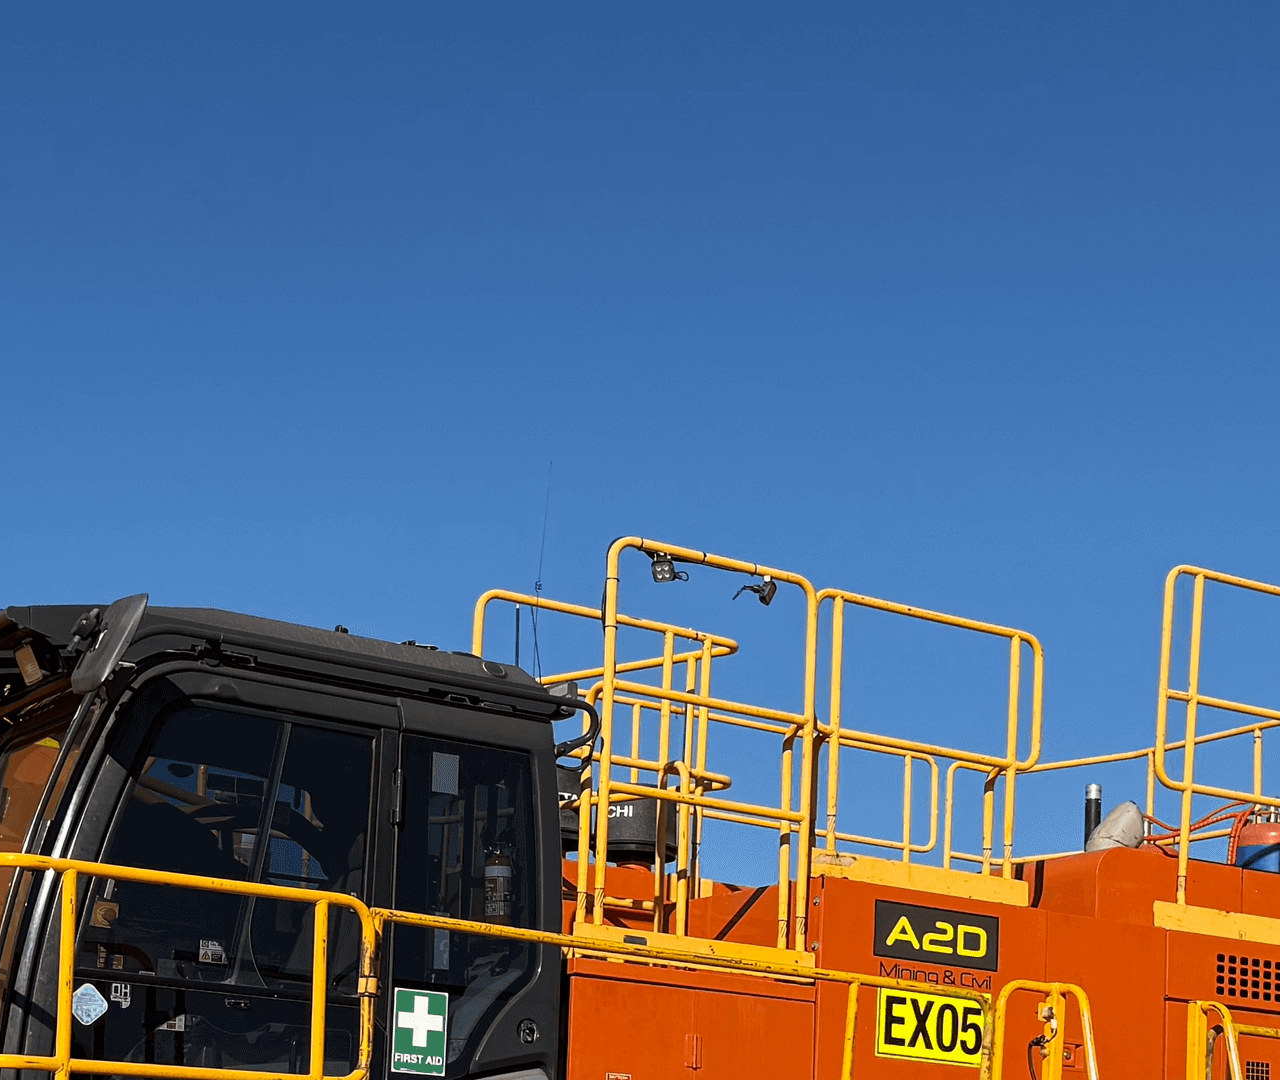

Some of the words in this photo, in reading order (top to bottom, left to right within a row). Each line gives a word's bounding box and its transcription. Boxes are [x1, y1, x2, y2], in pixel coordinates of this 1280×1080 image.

[885, 915, 988, 958] A2D
[879, 961, 939, 985] Mining
[943, 969, 956, 986] &
[960, 972, 992, 990] Civil
[883, 994, 983, 1056] EX05
[394, 1052, 424, 1064] FIRST
[425, 1055, 443, 1066] AID
